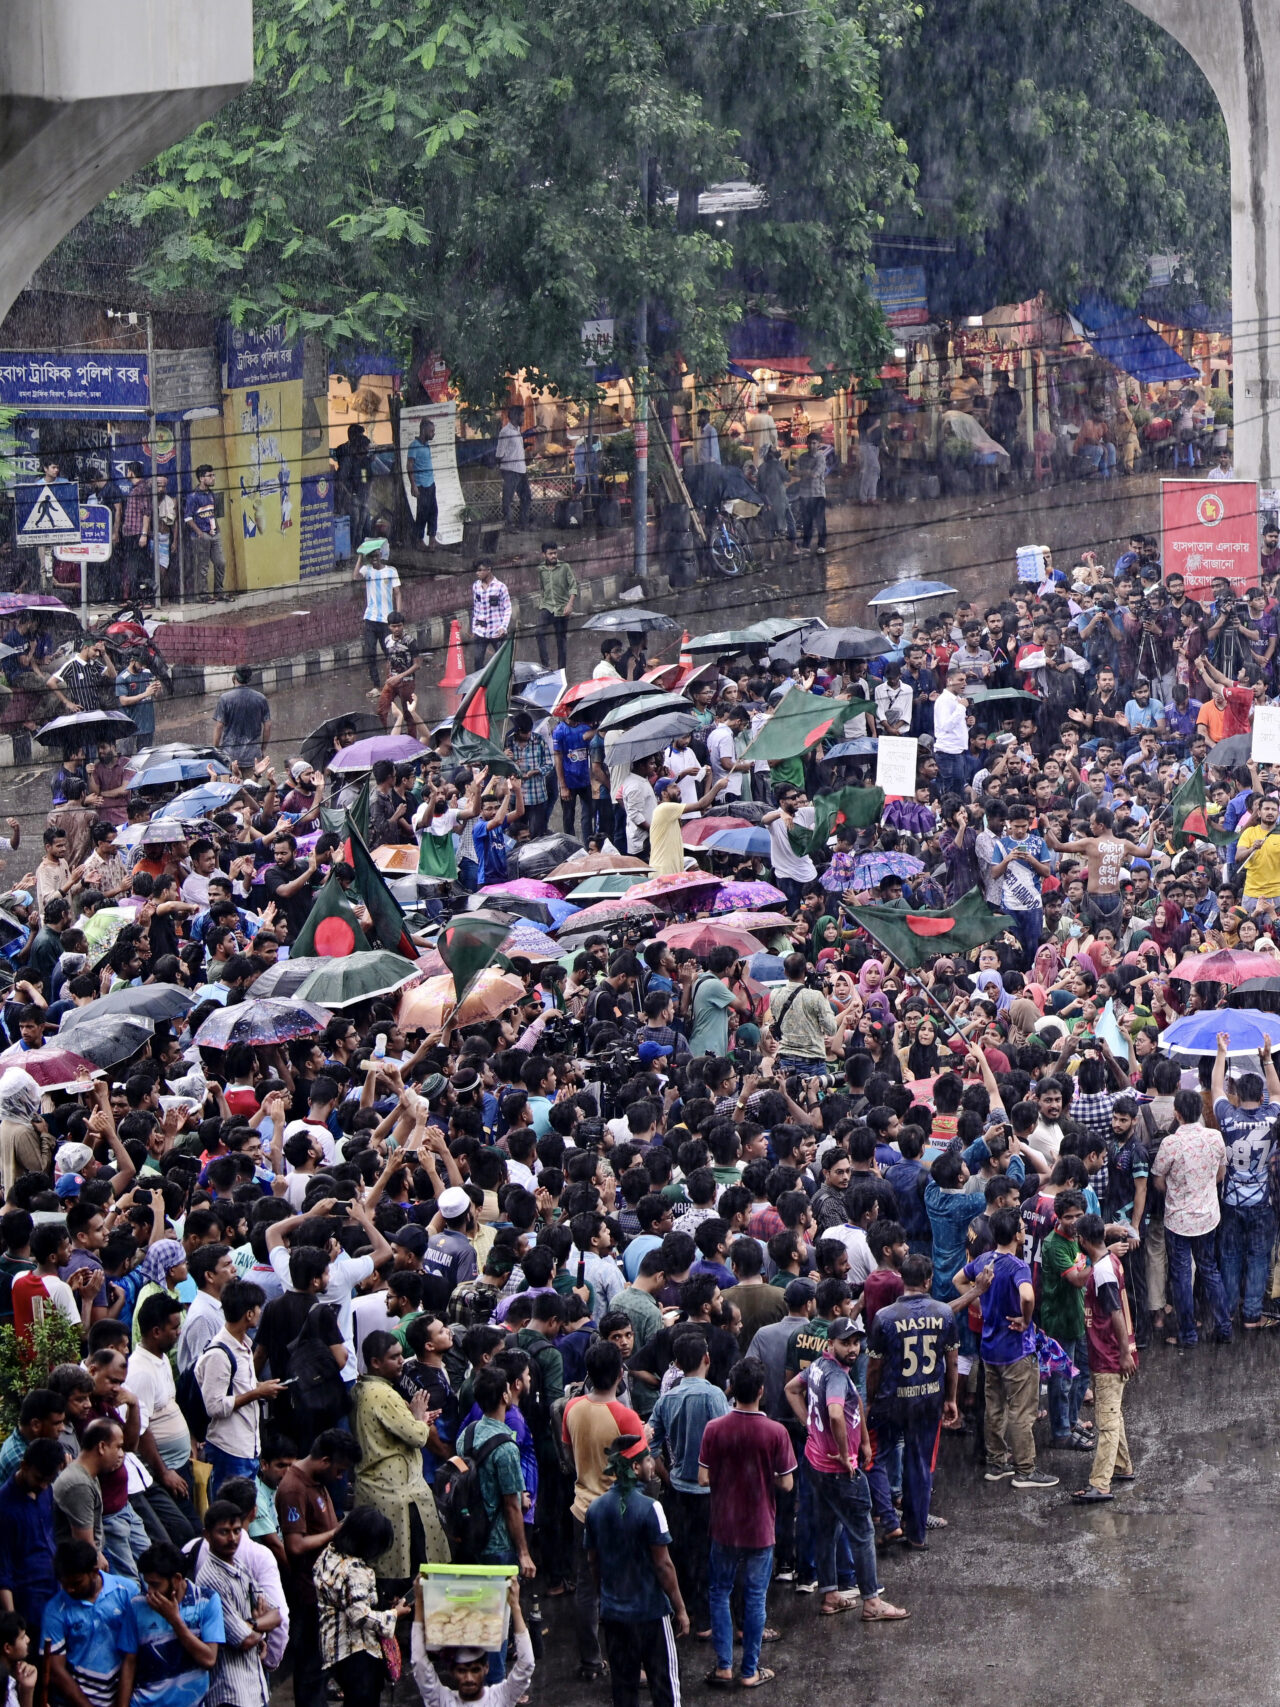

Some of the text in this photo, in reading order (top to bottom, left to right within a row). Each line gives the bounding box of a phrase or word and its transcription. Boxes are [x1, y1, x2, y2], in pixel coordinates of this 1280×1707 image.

[237, 350, 260, 370] ট্রাফিক
[261, 347, 279, 369] পুলিশ
[29, 361, 73, 384] ট্রাফিক
[76, 361, 113, 386] পুলিশ
[115, 366, 140, 384] বক্স
[1172, 541, 1249, 553] হাসপাতাল এলাকায়
[1202, 559, 1235, 570] বাজানো
[1231, 1139, 1271, 1172] 87
[895, 1316, 944, 1333] NASIM
[901, 1335, 938, 1377] 55
[897, 1385, 920, 1398] UNIVERSITY
[921, 1384, 926, 1396] OF
